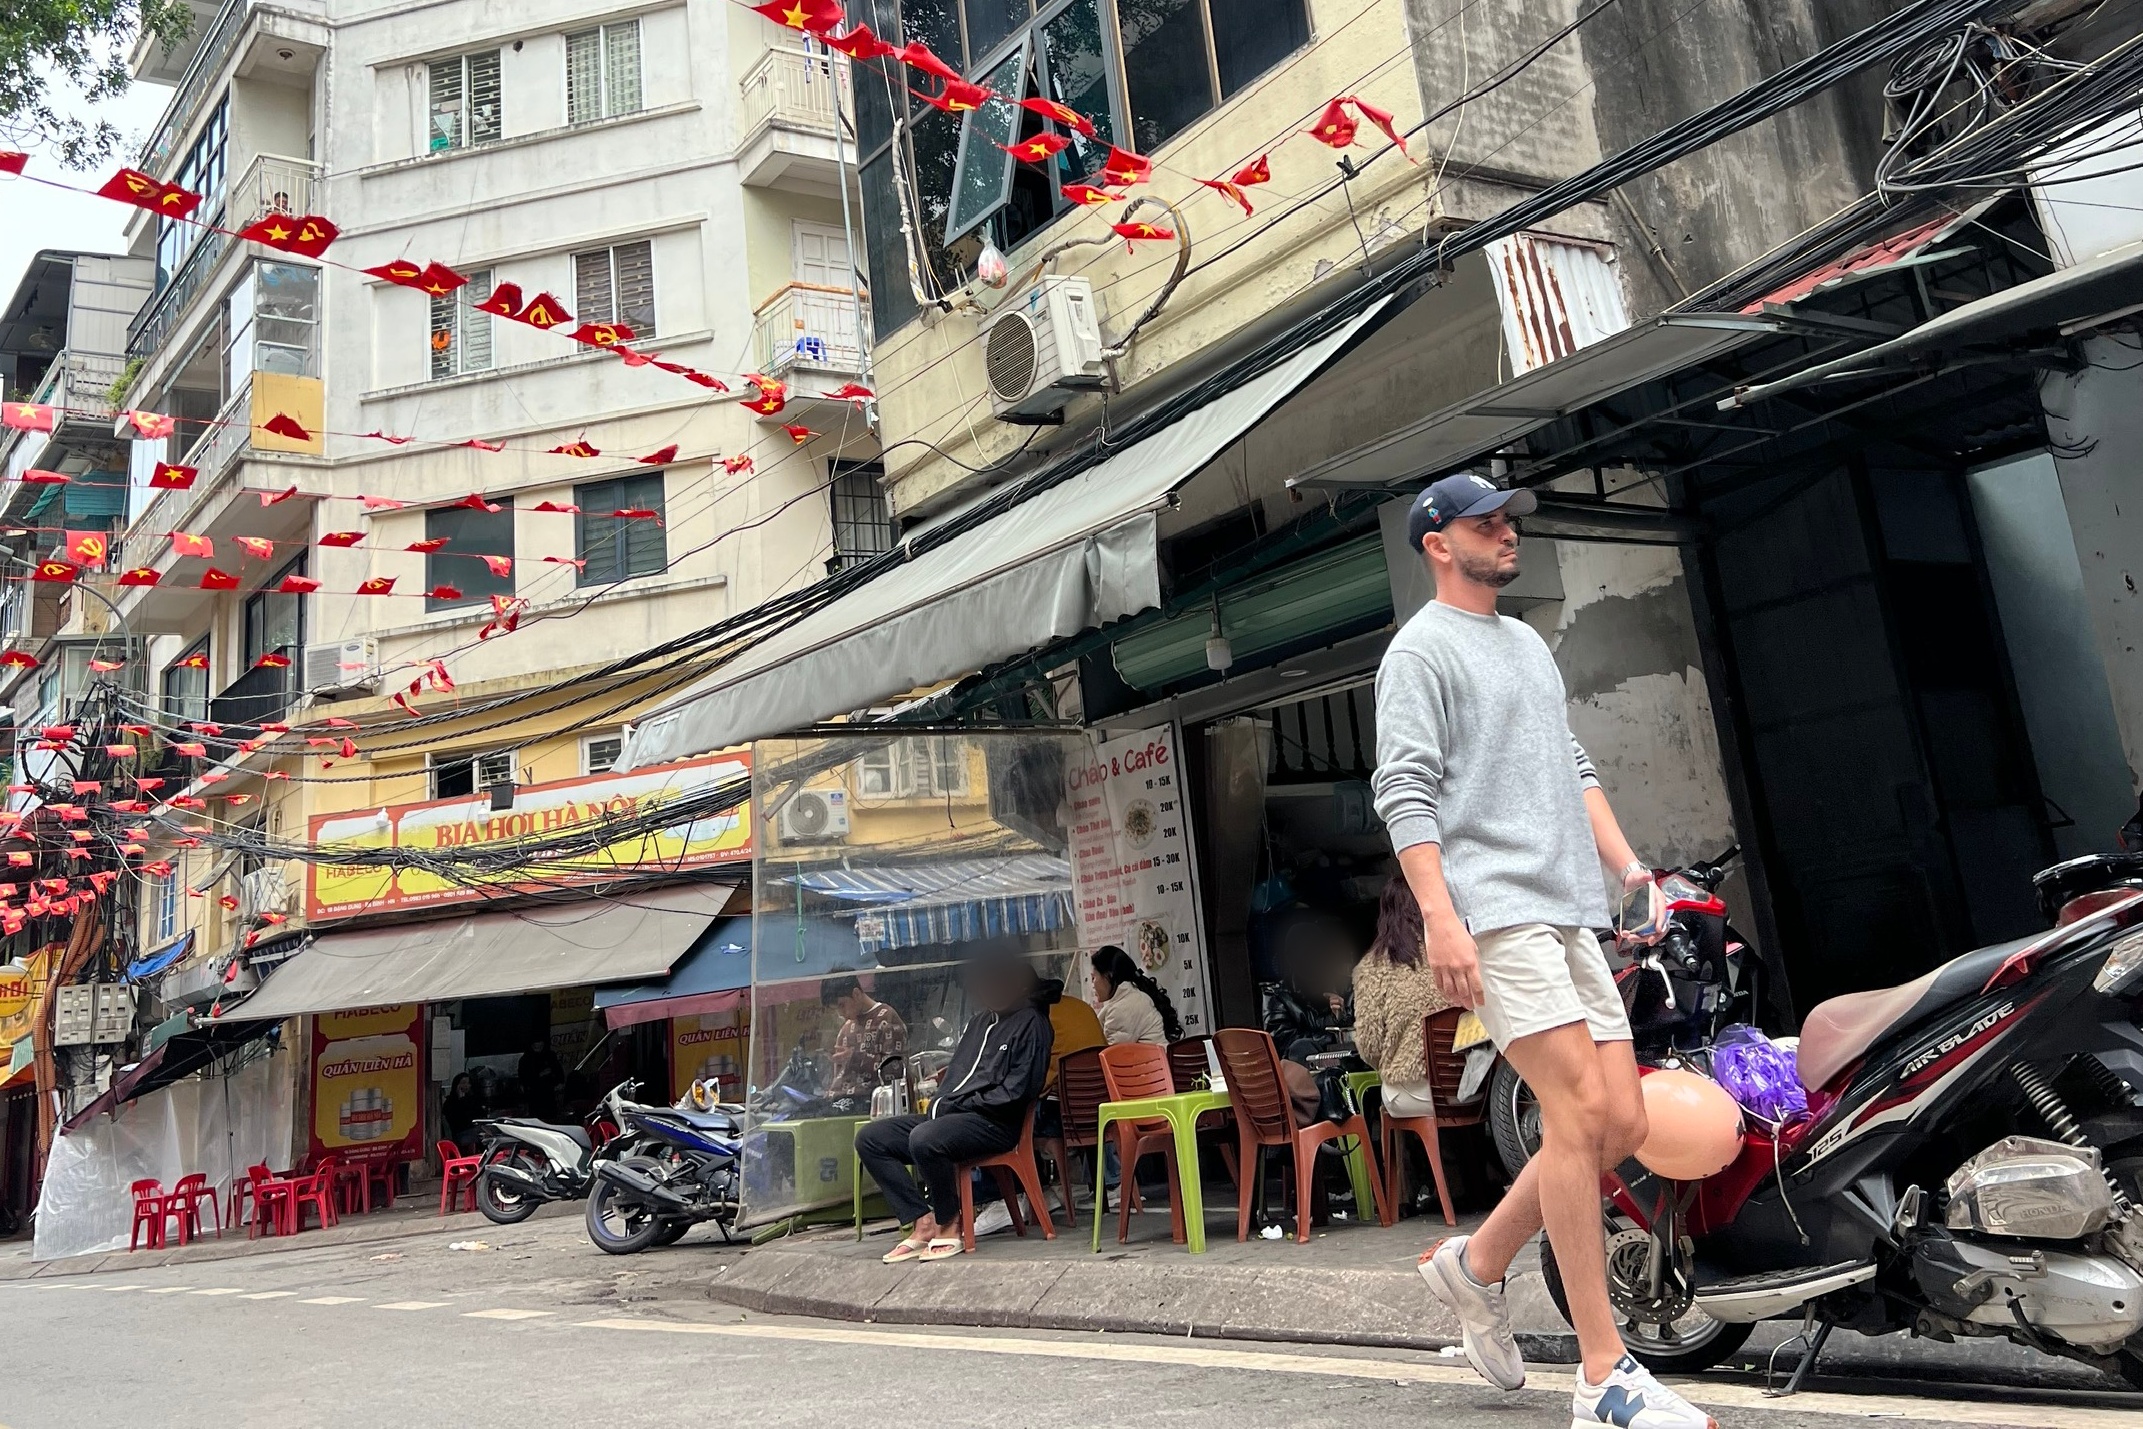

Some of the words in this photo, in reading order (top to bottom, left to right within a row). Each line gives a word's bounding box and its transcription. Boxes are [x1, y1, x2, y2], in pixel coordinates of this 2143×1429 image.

[1112, 757, 1120, 777] &
[1124, 739, 1169, 773] Café
[1145, 779, 1154, 790] 10
[1158, 775, 1171, 787] 15K
[1160, 800, 1174, 812] 20K
[435, 820, 480, 848] BIA
[1163, 827, 1177, 838] 20K
[1153, 857, 1161, 868] 15
[1166, 852, 1180, 864] 30K
[1157, 884, 1165, 895] 10
[1170, 881, 1184, 893] 15K
[1177, 932, 1190, 943] 10K
[1184, 960, 1193, 970] 5K
[1183, 987, 1196, 999] 20K
[1184, 1014, 1199, 1026] 25K
[678, 1029, 711, 1046] QUÁN
[1900, 1046, 1939, 1080] AIR
[1939, 1001, 2015, 1056] BLADE
[323, 1058, 360, 1078] QUÁN
[393, 1052, 413, 1068] HÀ
[1810, 1128, 1843, 1159] 125
[2020, 1203, 2071, 1219] HONDA
